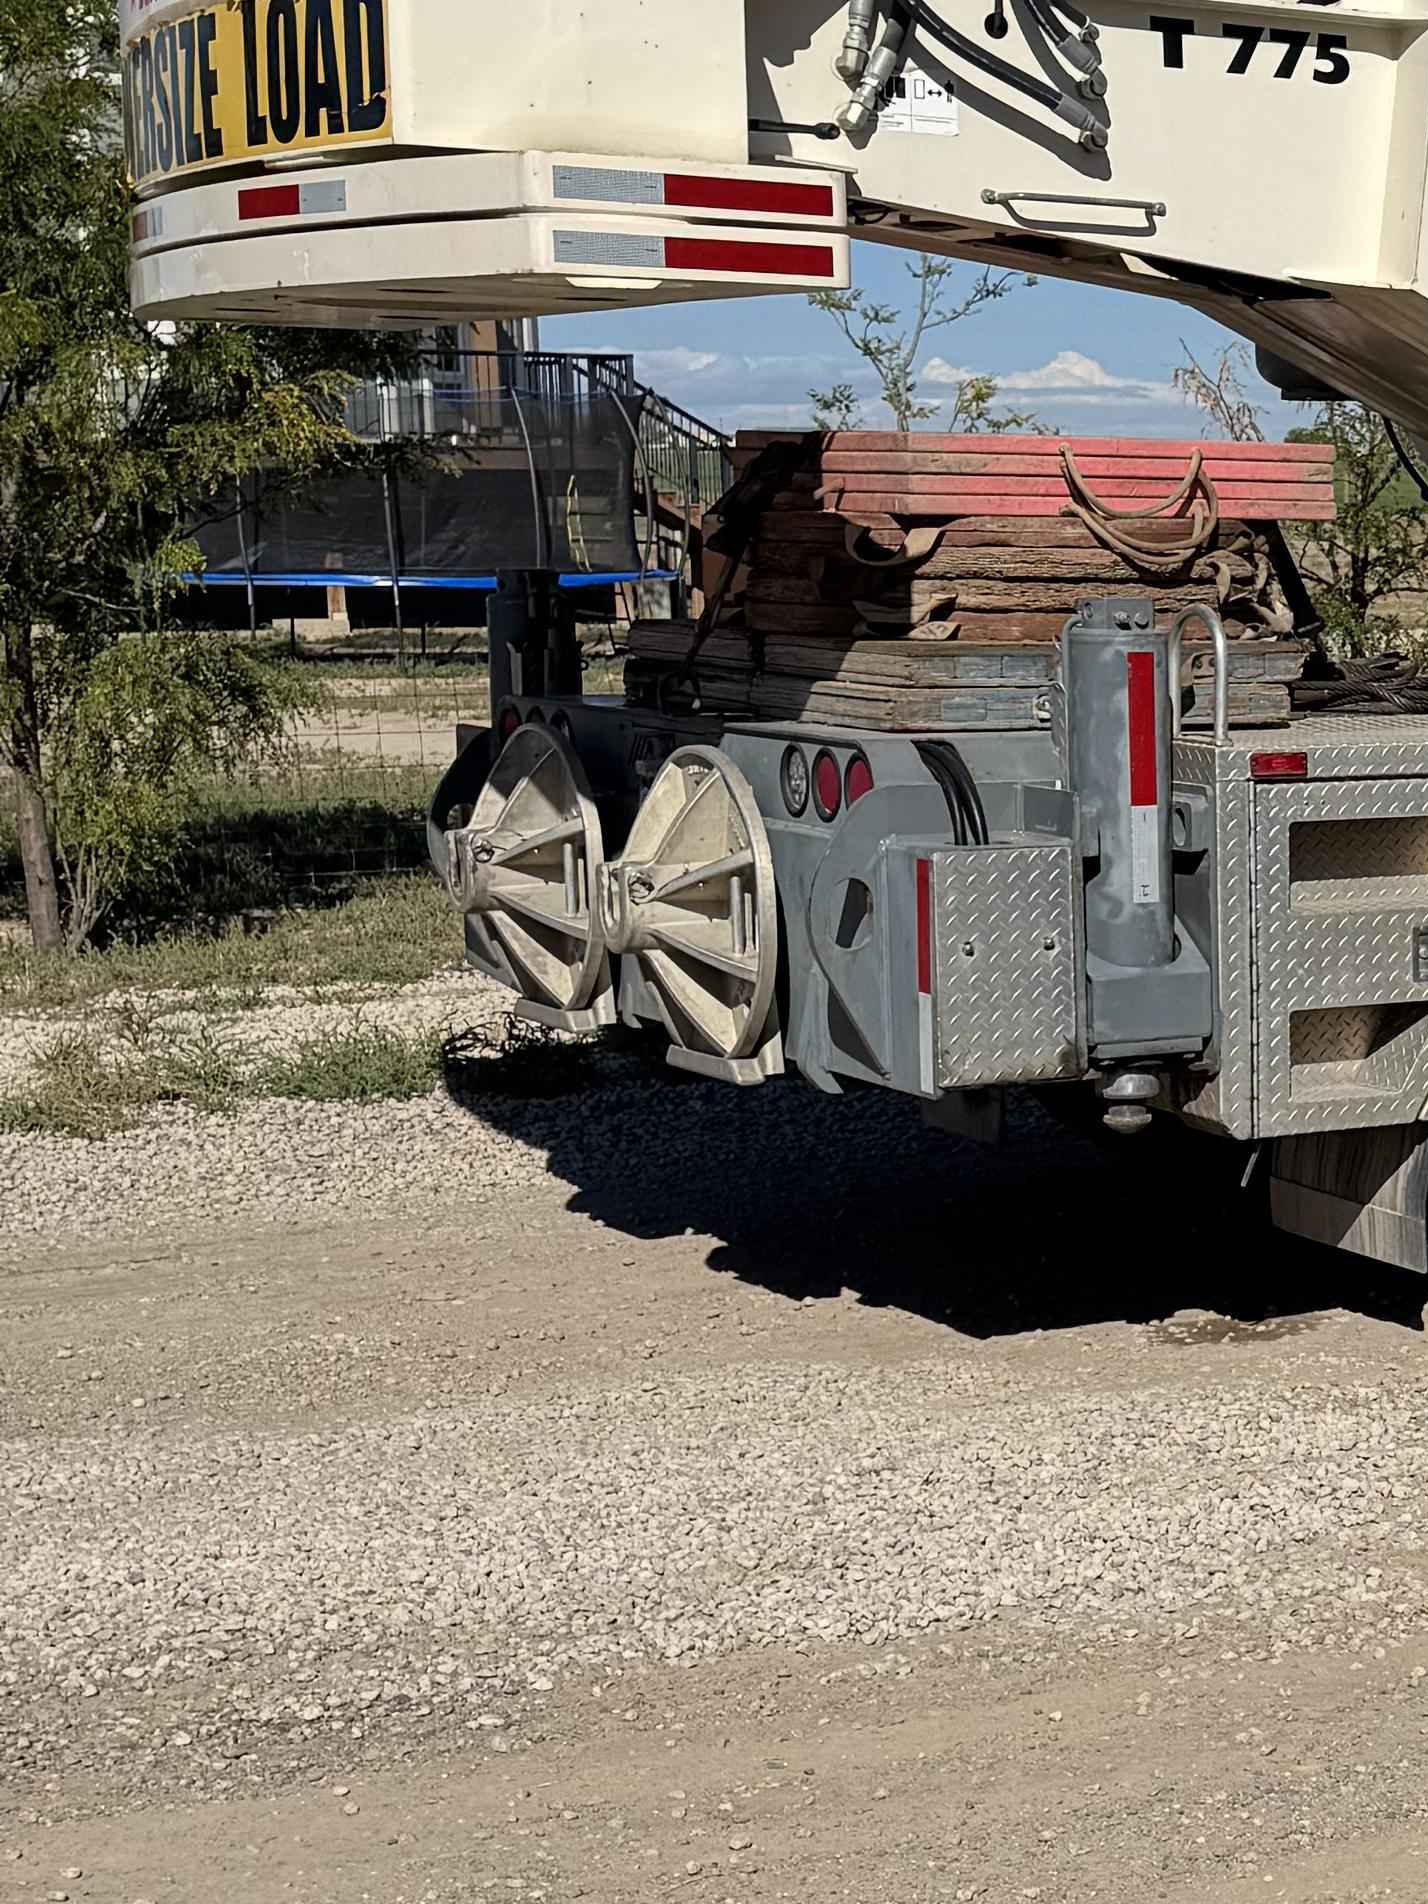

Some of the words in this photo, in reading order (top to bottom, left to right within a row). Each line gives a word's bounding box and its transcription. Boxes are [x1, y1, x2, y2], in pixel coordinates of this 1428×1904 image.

[122, 13, 224, 183] ERSIZE
[1149, 15, 1195, 69] T
[1221, 22, 1351, 85] 775
